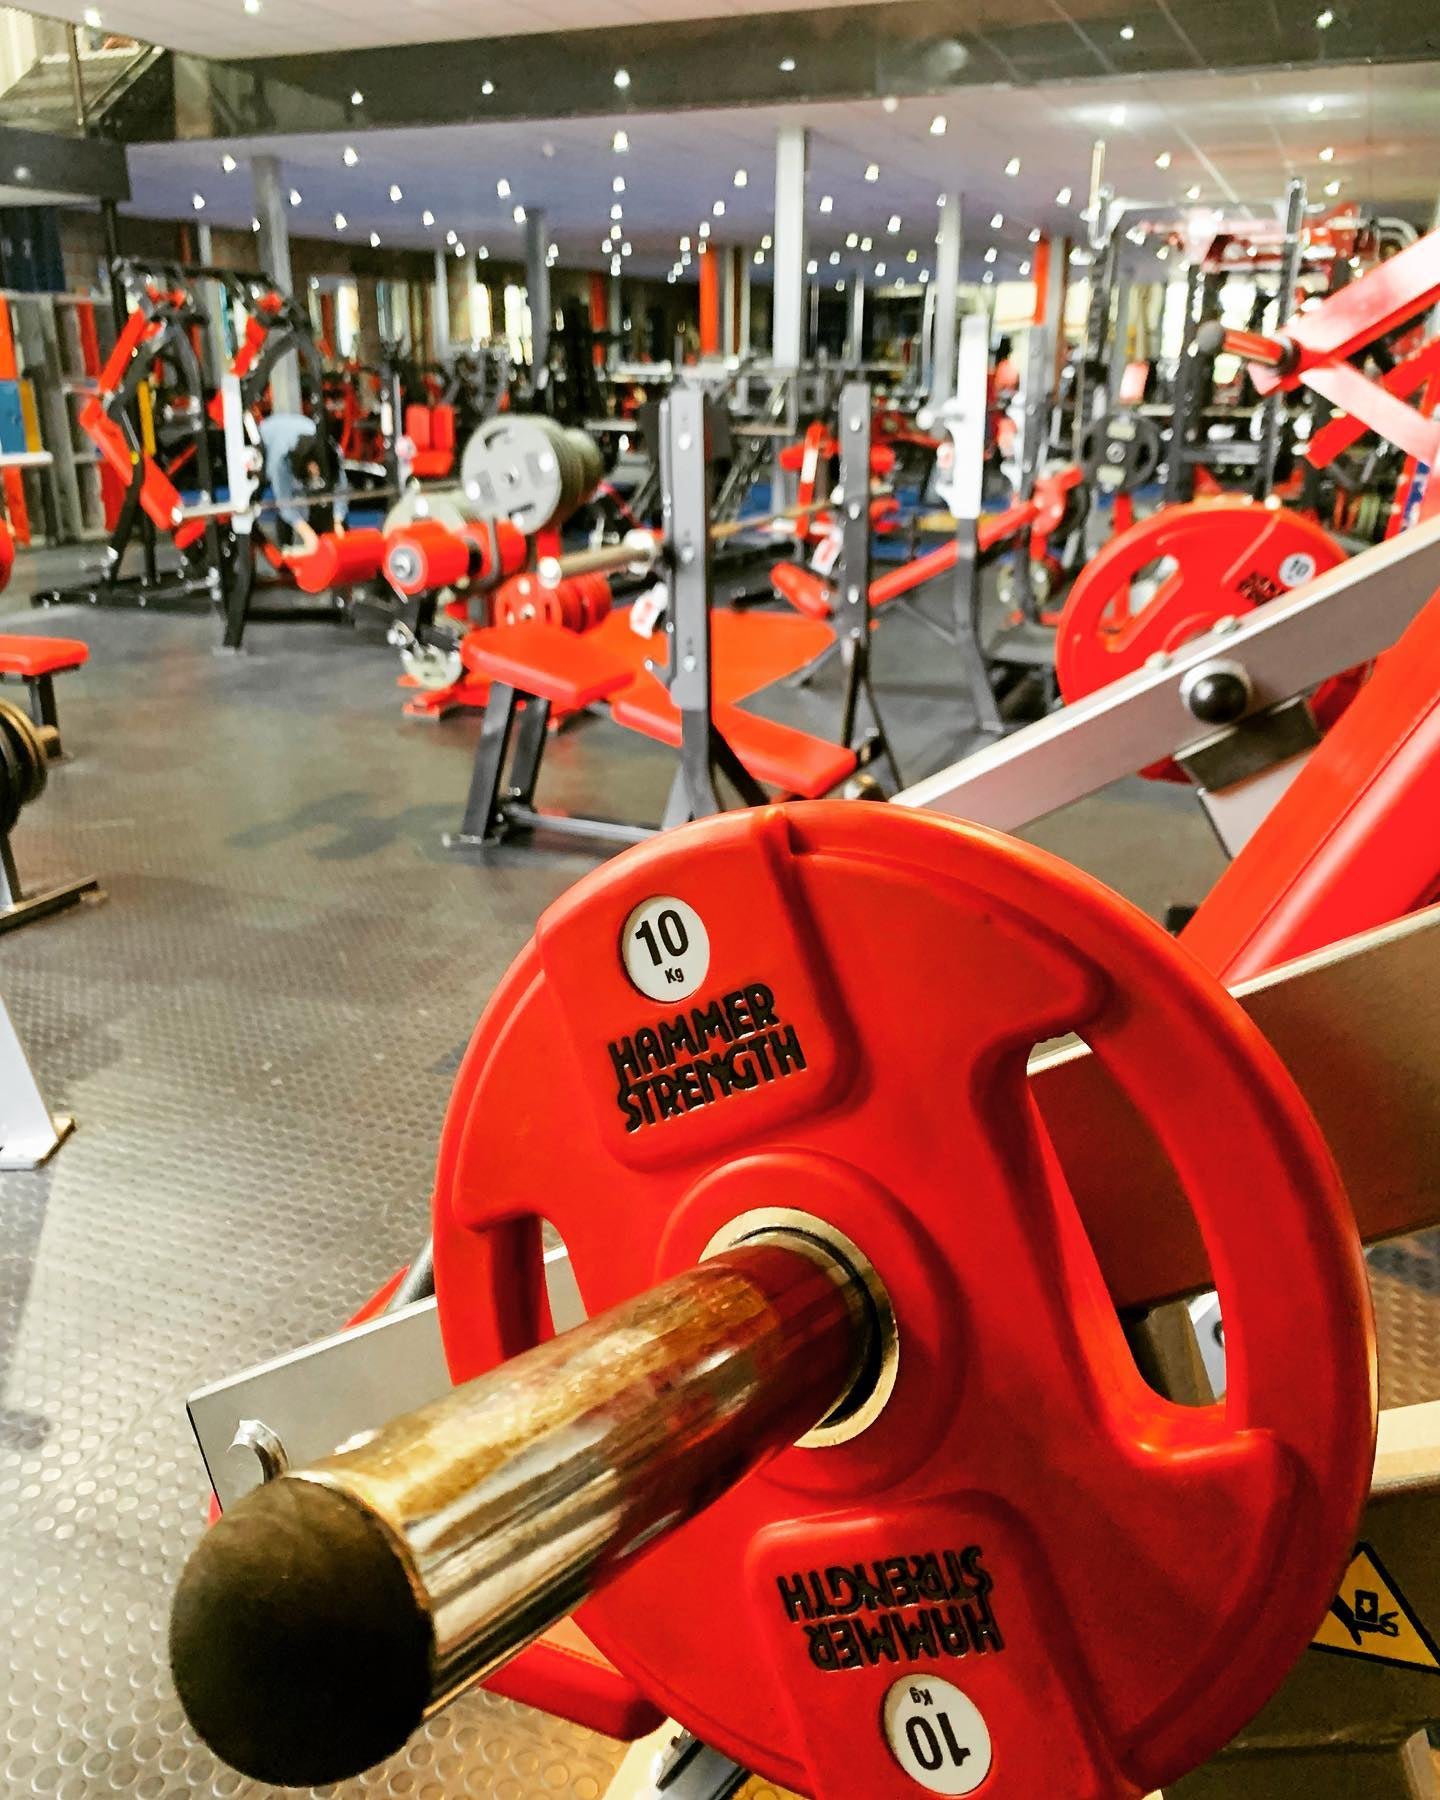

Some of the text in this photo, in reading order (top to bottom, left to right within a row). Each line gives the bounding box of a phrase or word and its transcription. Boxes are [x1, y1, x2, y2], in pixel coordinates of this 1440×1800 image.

[635, 909, 689, 967] 10
[664, 967, 684, 984] Kg
[607, 983, 781, 1080] HAMMER
[617, 1024, 808, 1134] STRENGTH
[776, 1545, 993, 1624] STRENGTH
[802, 1603, 1005, 1673] HAMMER
[909, 1686, 934, 1706] Kg
[905, 1712, 971, 1771] 10
